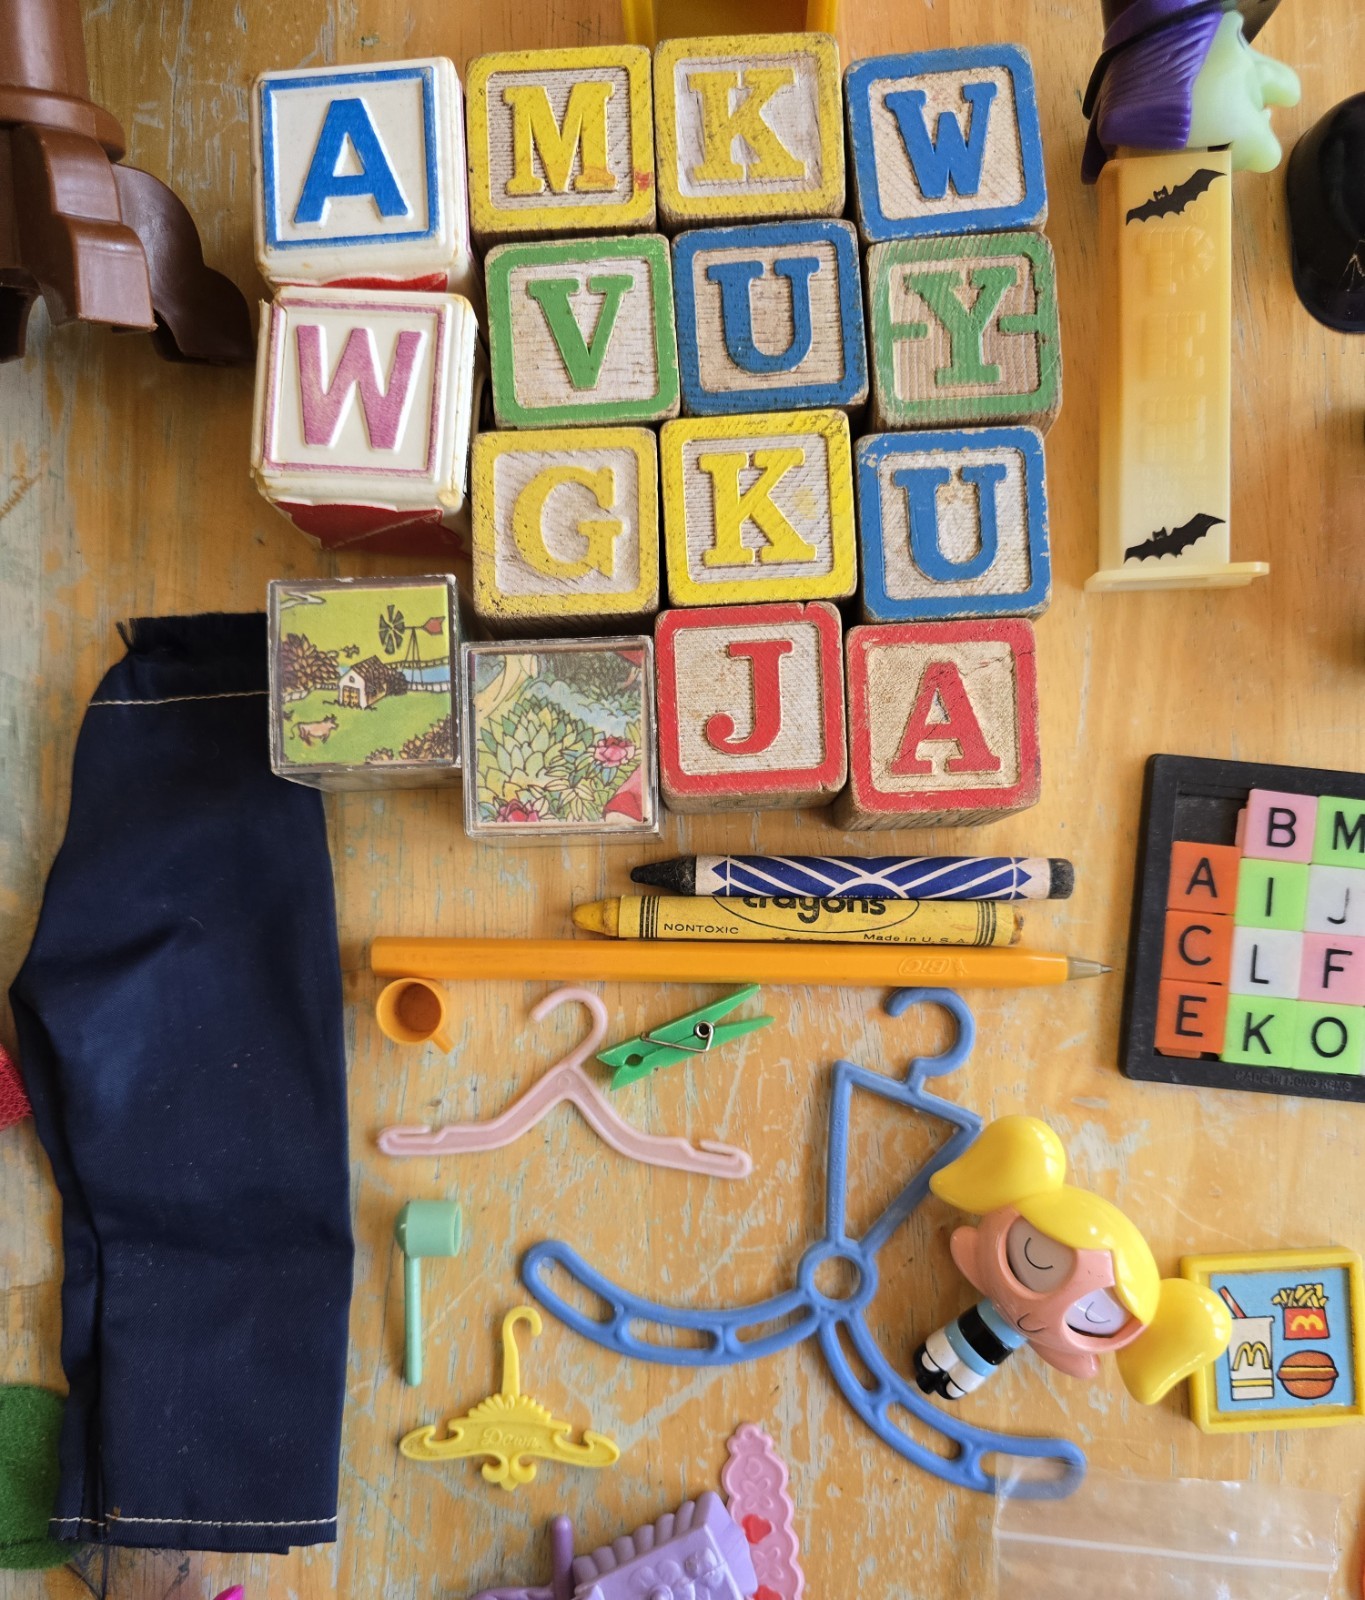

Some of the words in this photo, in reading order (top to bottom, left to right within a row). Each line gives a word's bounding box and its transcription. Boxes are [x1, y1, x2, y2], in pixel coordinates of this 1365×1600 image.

[504, 81, 618, 195] M
[687, 67, 806, 181] K
[884, 82, 998, 199] W
[293, 98, 409, 223] A
[528, 274, 634, 389] V
[707, 257, 820, 374] U
[903, 266, 1018, 386] Y
[296, 325, 423, 449] W
[512, 465, 623, 580] G
[699, 447, 818, 566] K
[891, 463, 1007, 582] U
[705, 640, 794, 754] J
[890, 661, 1001, 776] A
[1266, 807, 1297, 848] B
[1332, 811, 1365, 854] M
[1185, 857, 1218, 898] A
[1265, 877, 1274, 917] I
[742, 896, 886, 924] crayons
[1327, 887, 1350, 924] J
[663, 923, 739, 935] NONTOXIC
[863, 933, 901, 942] Made
[1178, 925, 1212, 966] C
[1250, 944, 1270, 985] L
[1322, 947, 1353, 989] F
[1174, 995, 1207, 1037] E
[1242, 1012, 1274, 1054] K
[1310, 1016, 1348, 1058] O
